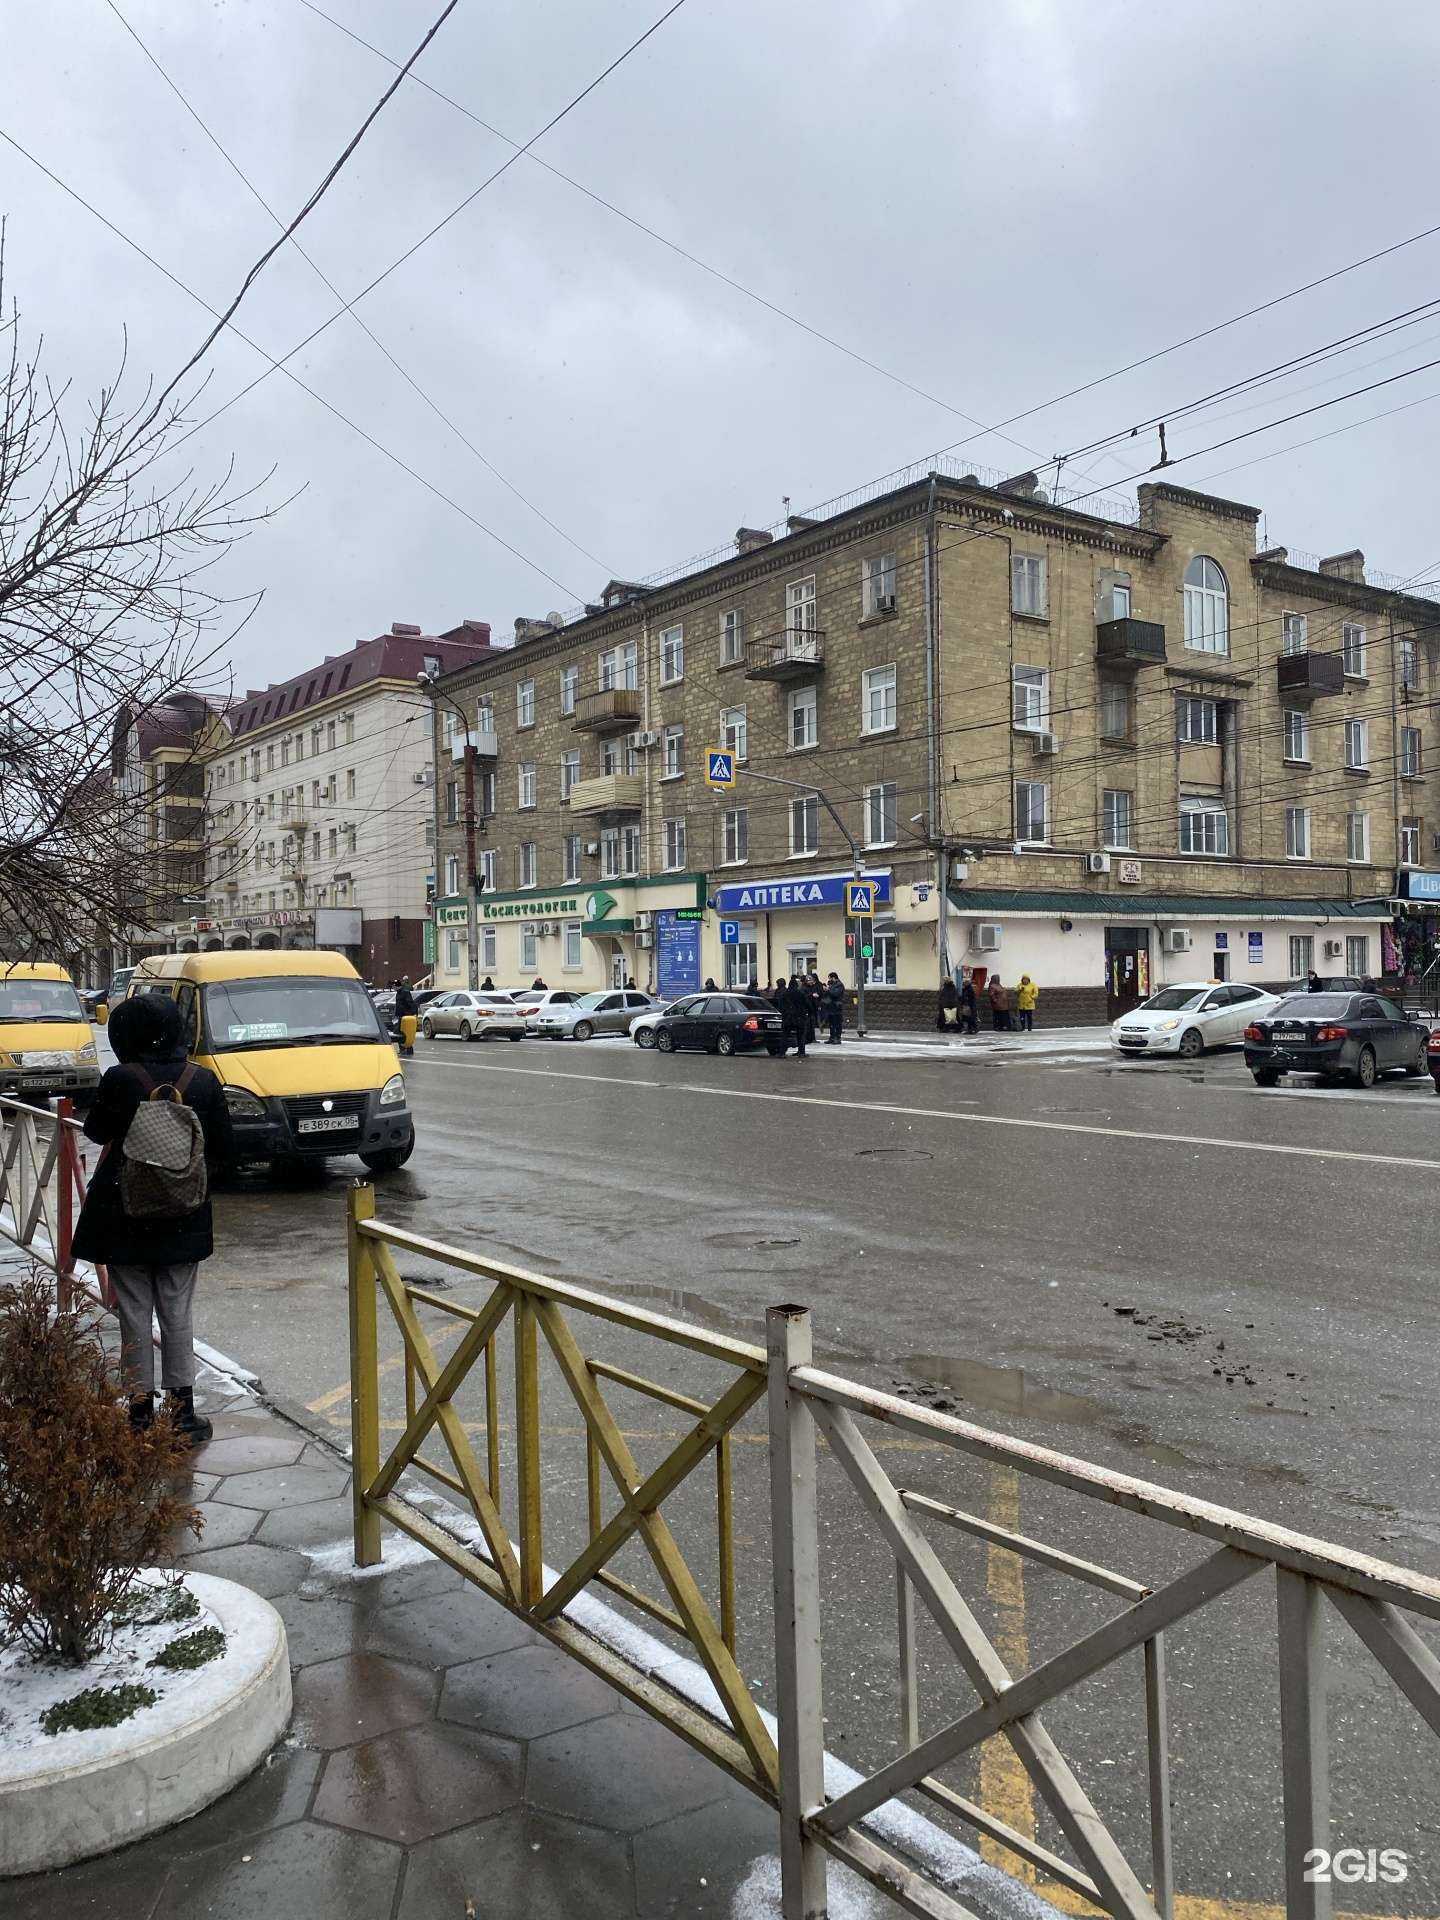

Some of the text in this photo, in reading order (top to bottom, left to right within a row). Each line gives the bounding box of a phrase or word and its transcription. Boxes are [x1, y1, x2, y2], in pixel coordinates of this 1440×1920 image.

[1421, 877, 1440, 892] Цв
[739, 884, 824, 906] АПТЕКА
[440, 900, 577, 923] Цент Косметологии
[231, 1028, 247, 1041] 7
